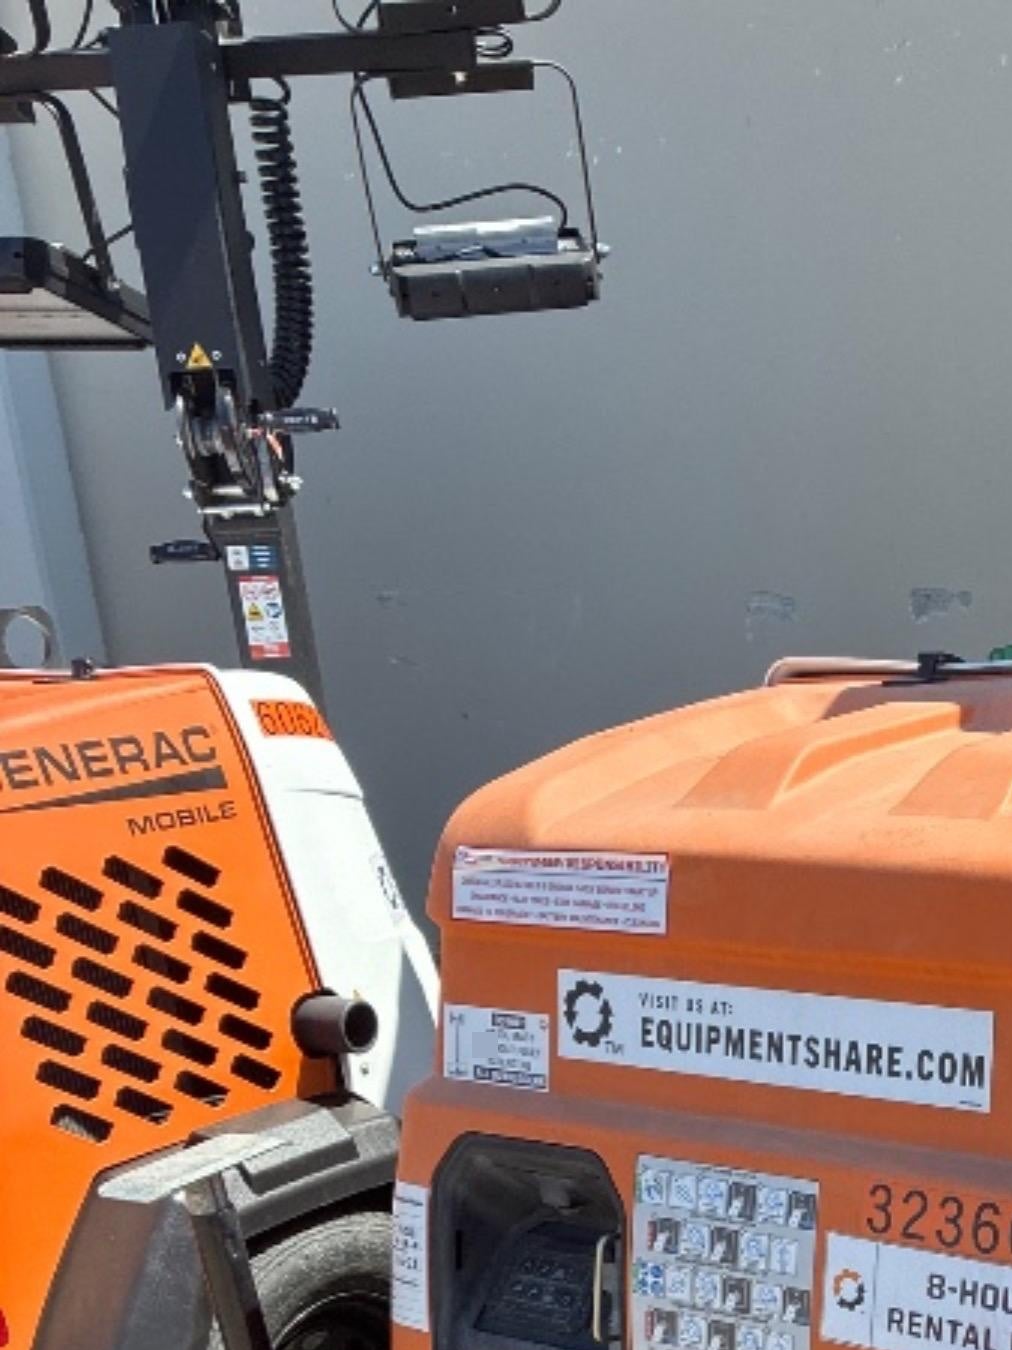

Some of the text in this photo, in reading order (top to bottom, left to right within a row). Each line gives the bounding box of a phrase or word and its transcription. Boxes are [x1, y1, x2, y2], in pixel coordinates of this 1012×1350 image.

[0, 725, 216, 792] ENERAC
[127, 800, 237, 837] MOBILE
[638, 992, 733, 1016] VISIT US AT:
[641, 1016, 986, 1088] EQUIPMENTSHARE.COM
